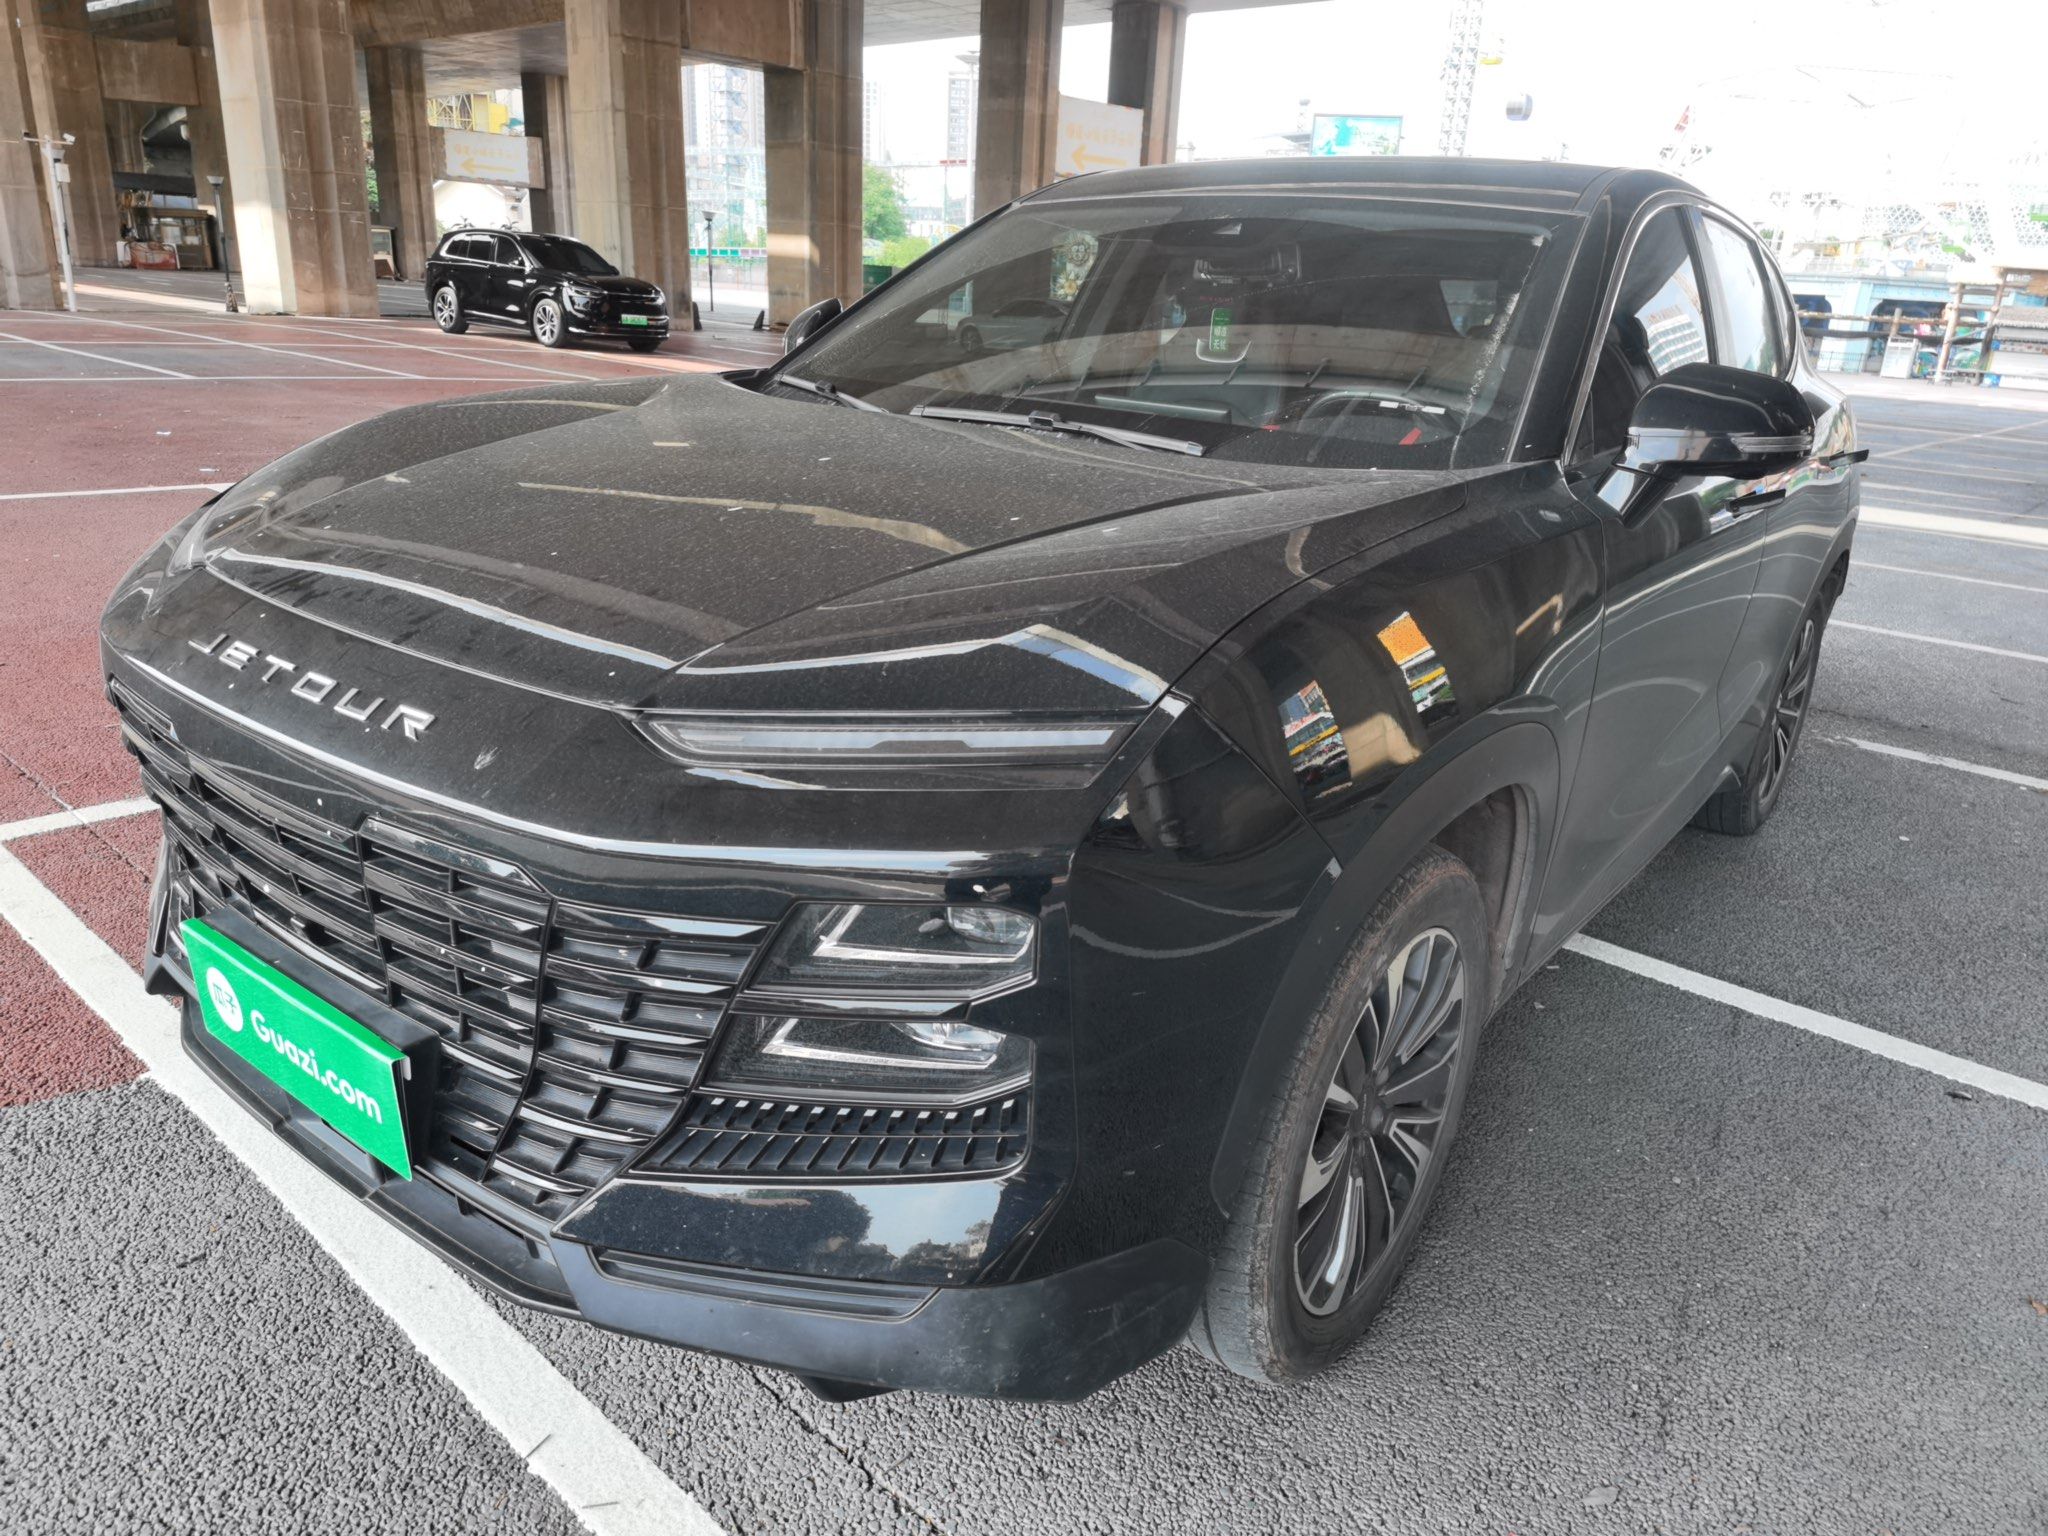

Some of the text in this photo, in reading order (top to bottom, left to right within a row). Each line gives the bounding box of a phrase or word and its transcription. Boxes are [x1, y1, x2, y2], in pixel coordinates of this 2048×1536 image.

[187, 633, 436, 742] JETOUR
[212, 982, 237, 1015] 瓜子
[250, 1009, 383, 1125] Guazi.com
